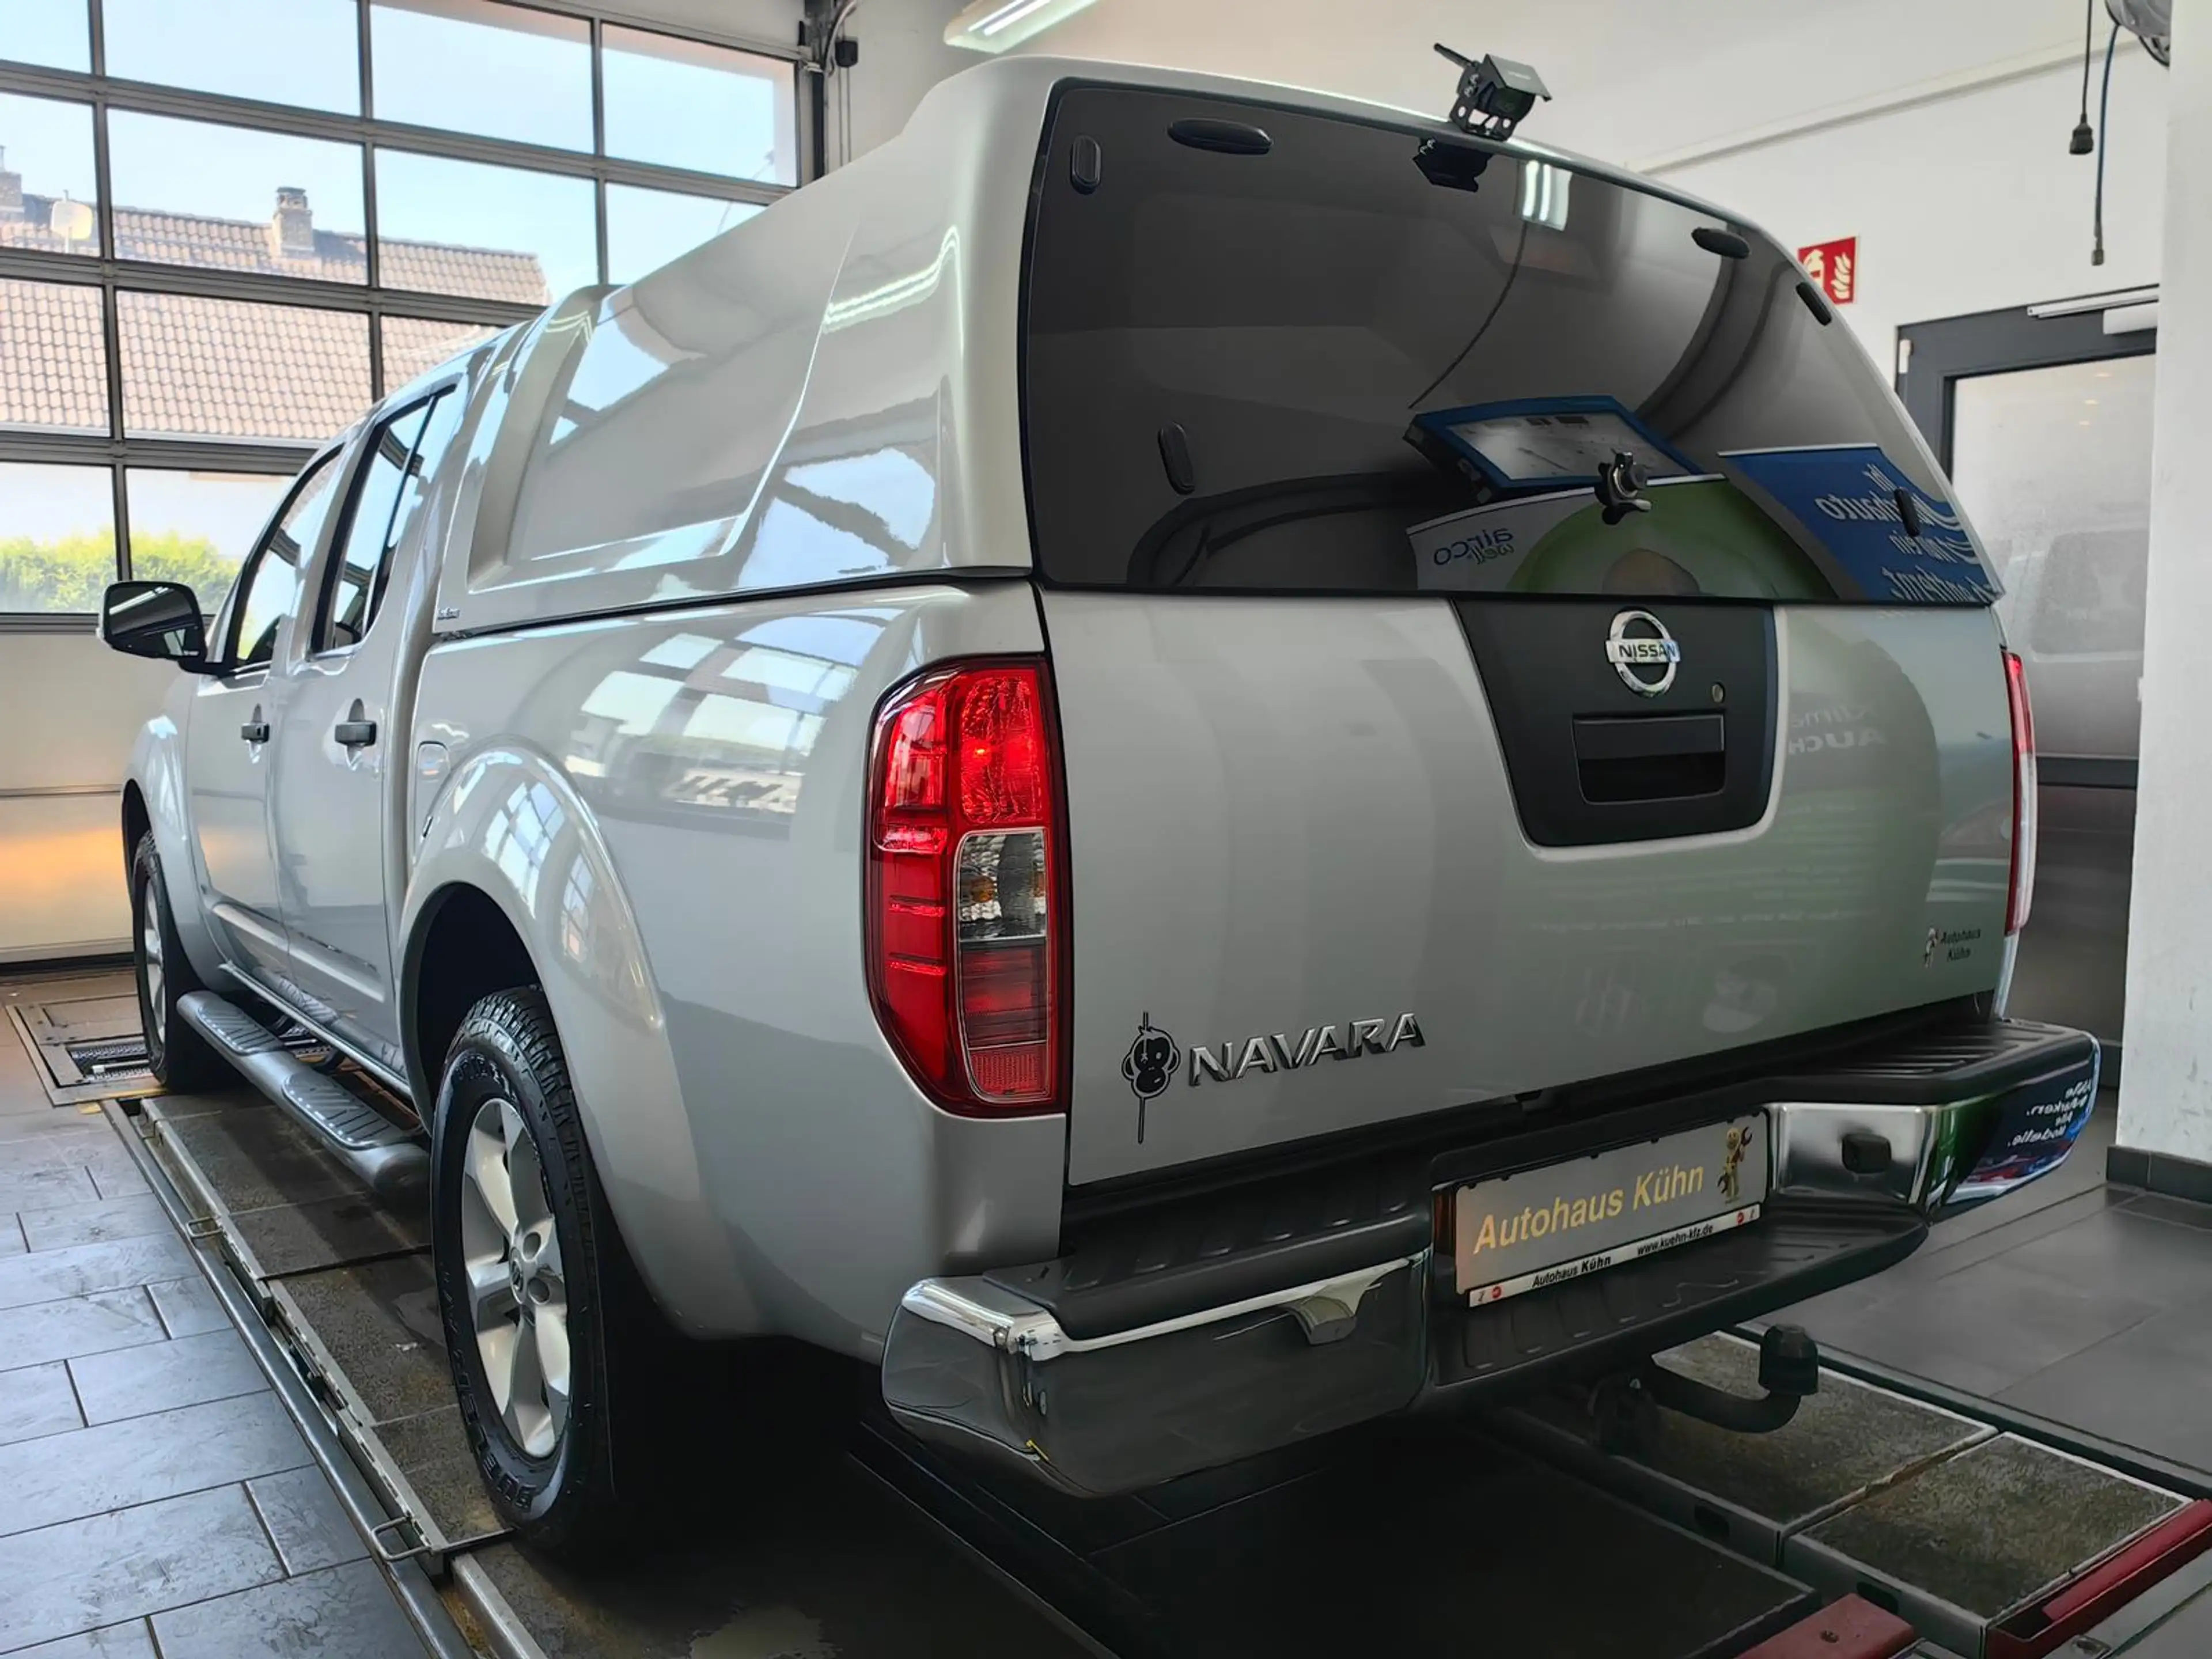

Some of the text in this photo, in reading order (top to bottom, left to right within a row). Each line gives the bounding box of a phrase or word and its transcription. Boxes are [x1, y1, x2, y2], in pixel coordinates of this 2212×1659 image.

[1618, 643, 1676, 658] NISSAN
[1188, 1012, 1426, 1087] NAVARA
[1473, 1164, 1705, 1255] Autohaus Kühn
[1531, 1264, 1578, 1288] Autohaus
[1581, 1255, 1612, 1273] Kühn
